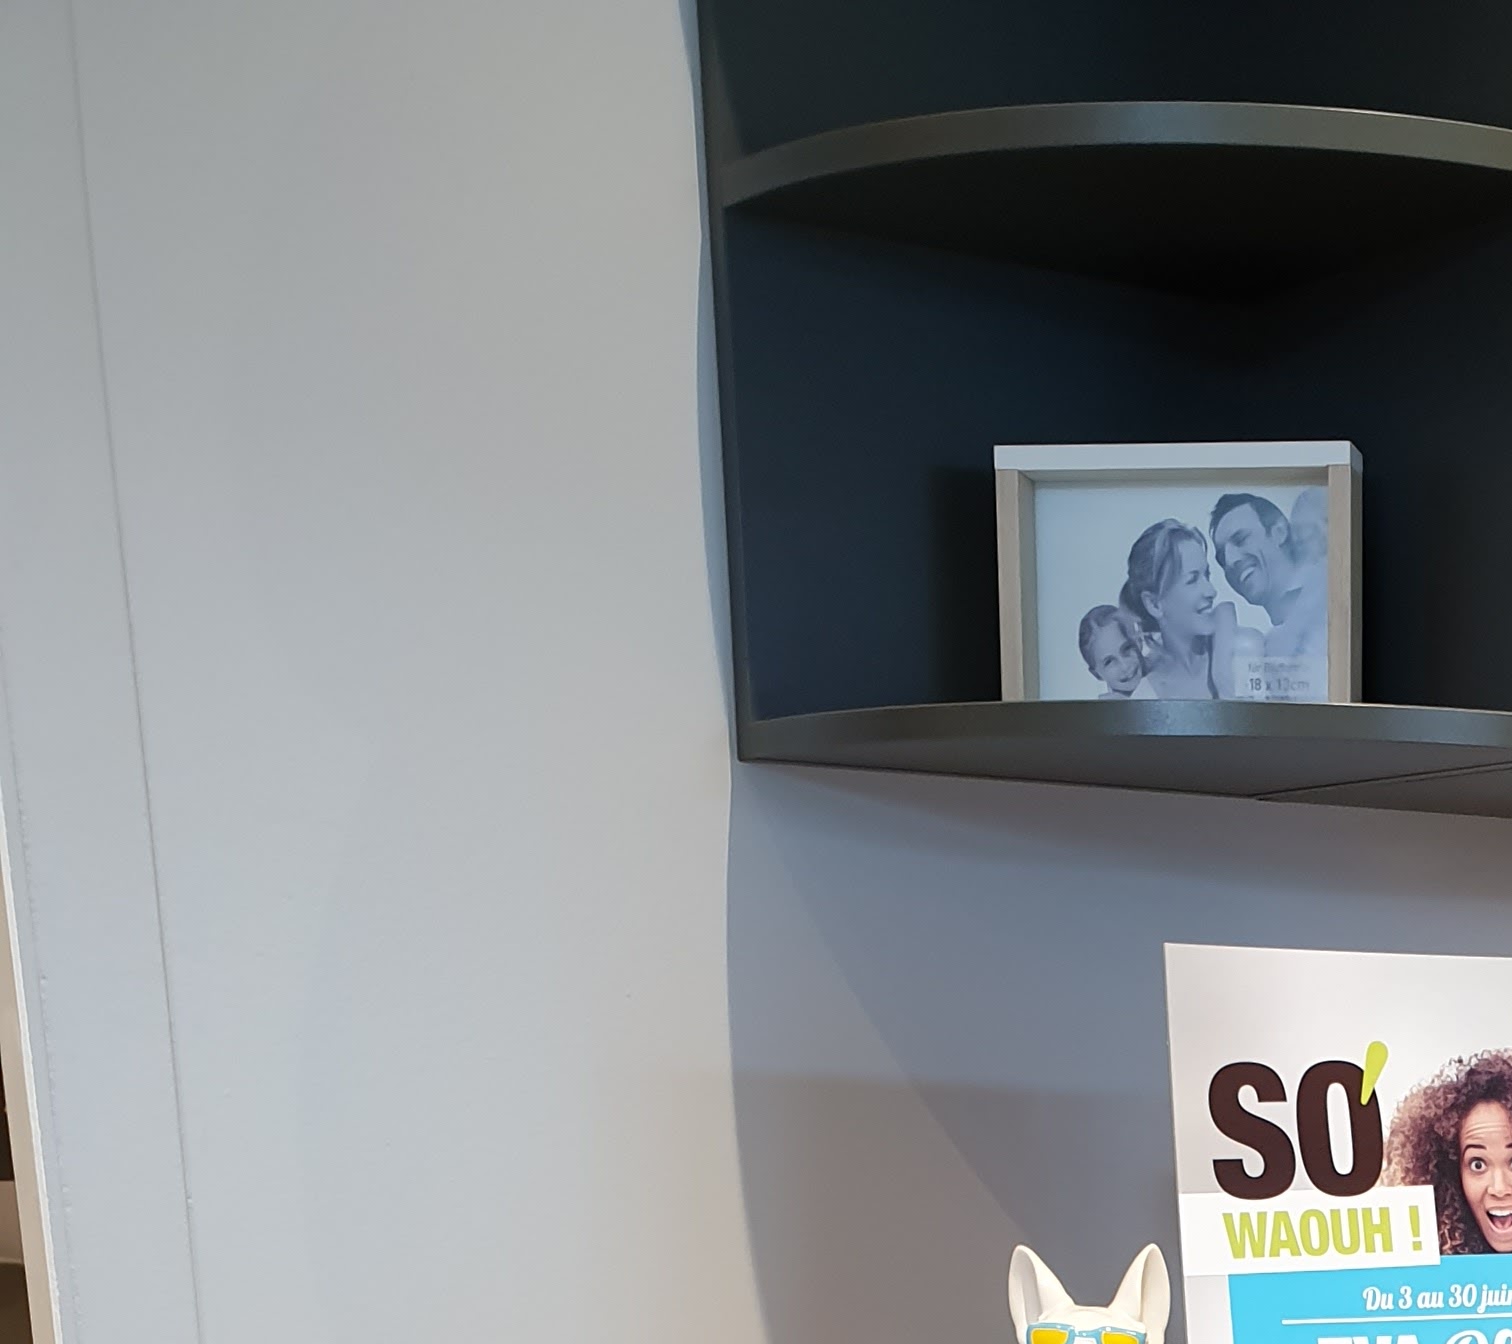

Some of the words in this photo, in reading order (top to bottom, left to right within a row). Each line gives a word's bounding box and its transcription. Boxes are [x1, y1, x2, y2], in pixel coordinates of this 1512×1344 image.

[1248, 677, 1263, 692] 18
[1221, 1207, 1394, 1260] WAOUH
[1361, 1285, 1394, 1311] Du
[1397, 1285, 1413, 1310] 3
[1416, 1289, 1445, 1309] au
[1448, 1283, 1478, 1308] 30
